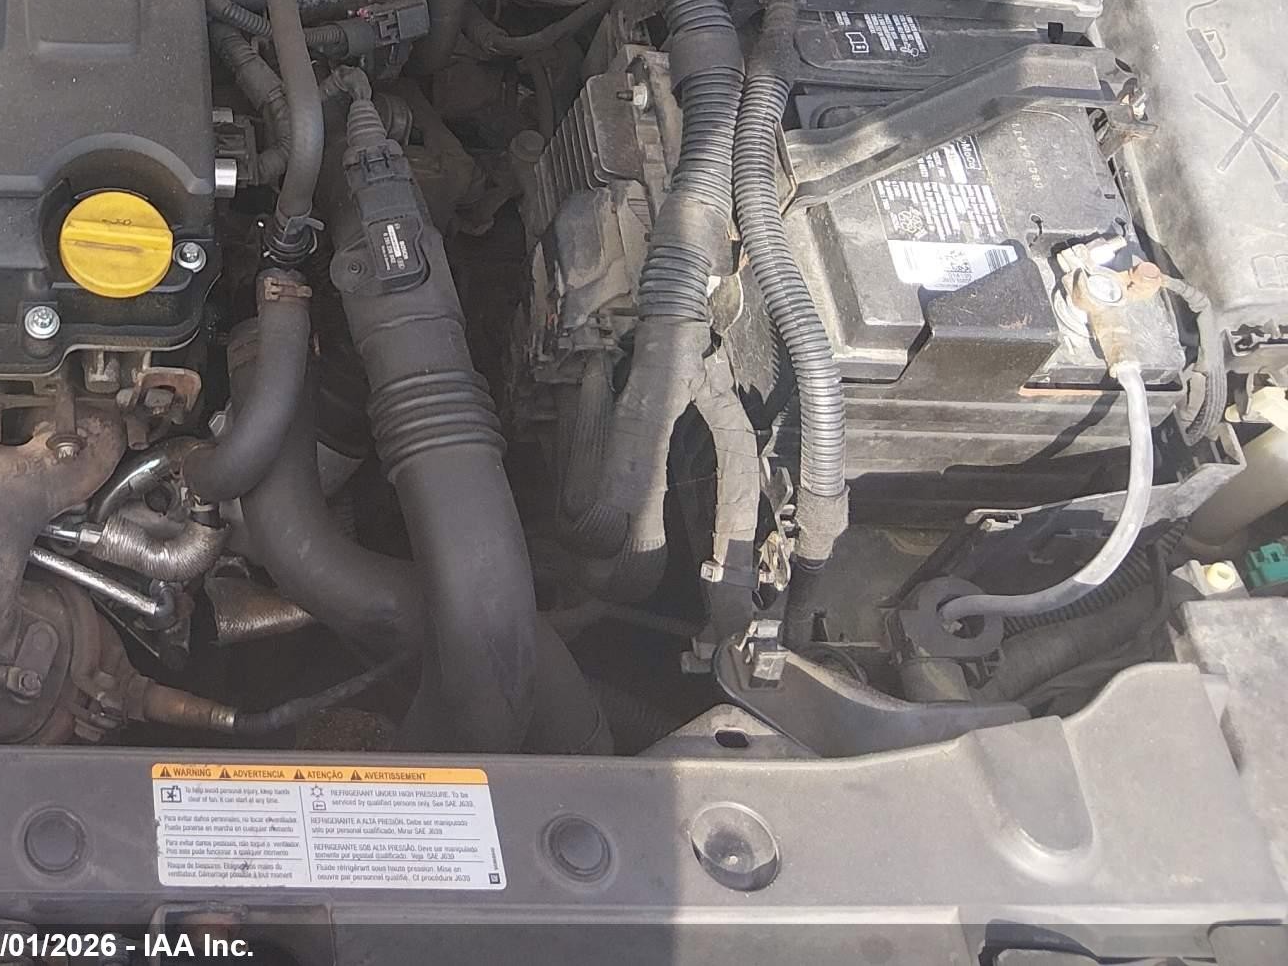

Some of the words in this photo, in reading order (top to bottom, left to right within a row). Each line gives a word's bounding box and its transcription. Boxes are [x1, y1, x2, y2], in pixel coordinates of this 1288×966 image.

[173, 768, 211, 777] WARNING
[233, 770, 285, 778] ADVERTENCIA
[307, 769, 343, 780] ATENÇÃO
[364, 772, 426, 780] AVERTISSEMENT
